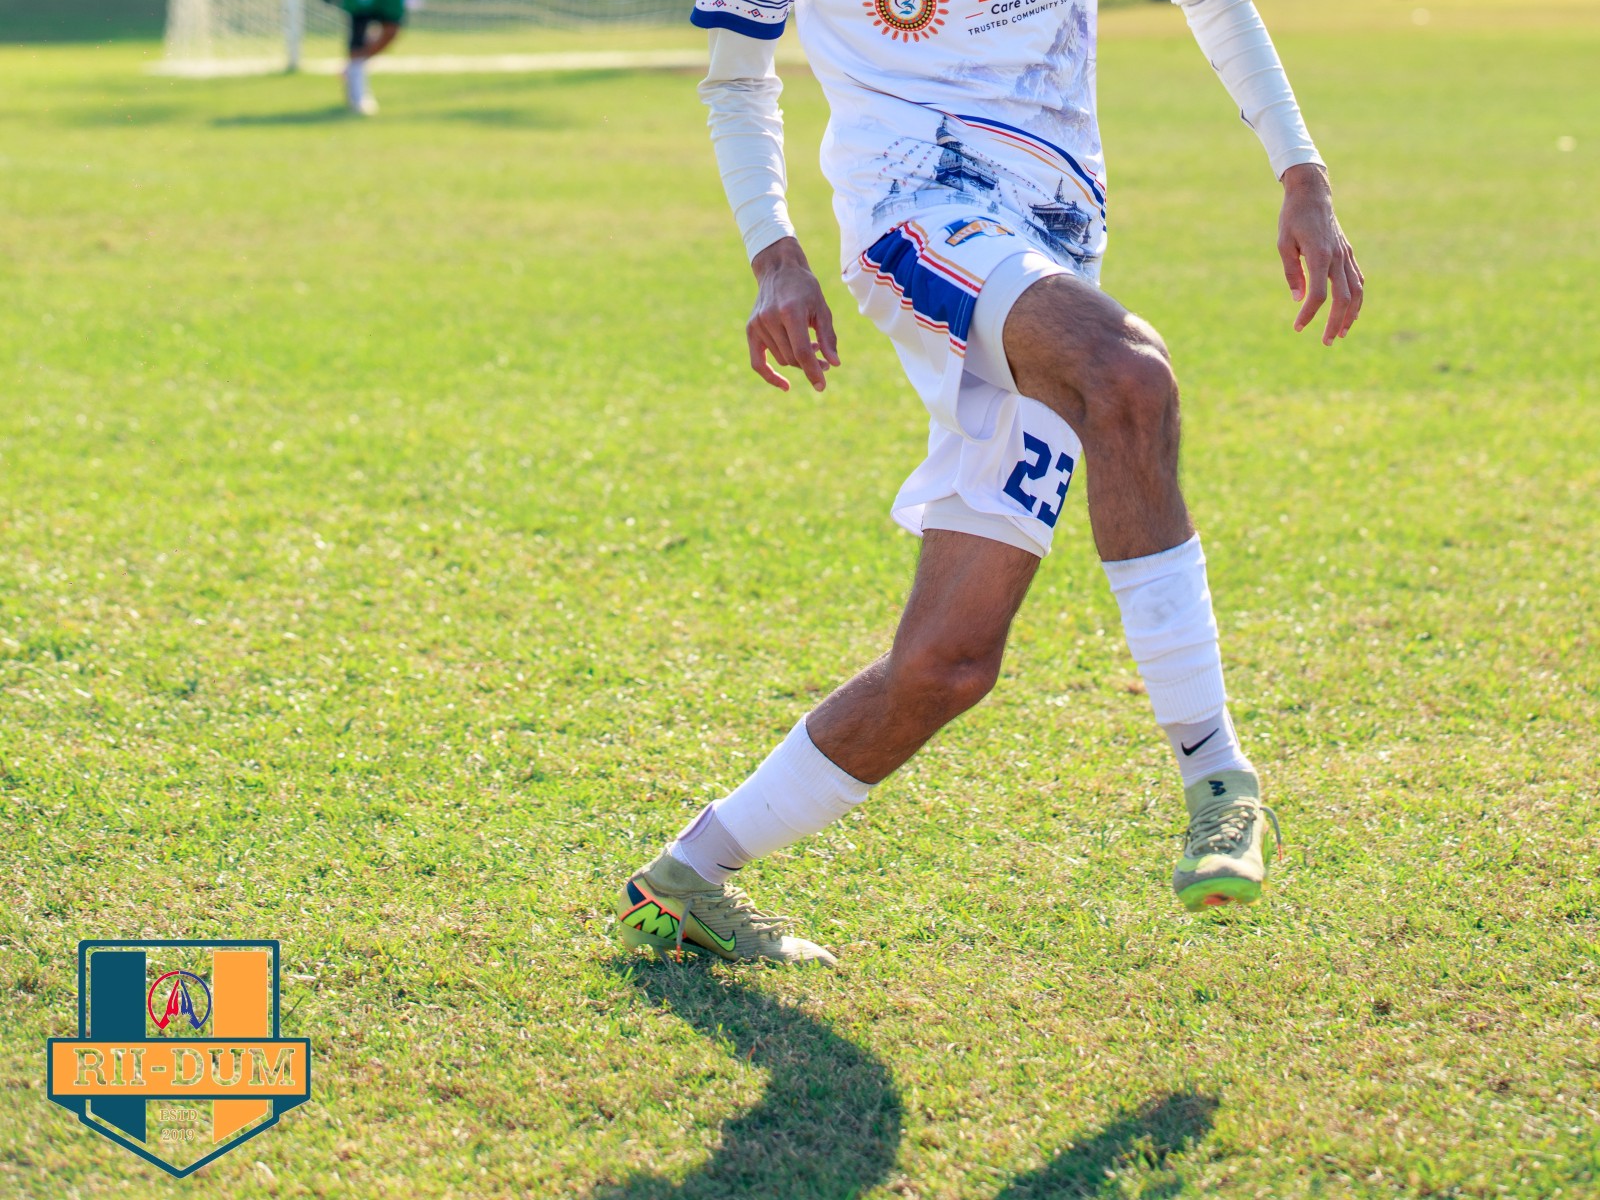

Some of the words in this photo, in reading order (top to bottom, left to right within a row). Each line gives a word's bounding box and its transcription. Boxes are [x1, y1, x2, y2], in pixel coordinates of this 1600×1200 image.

[968, 19, 1009, 36] TRUSTED
[1011, 0, 1059, 24] COMMUNITY
[991, 0, 1021, 15] Care
[1002, 430, 1075, 529] 23
